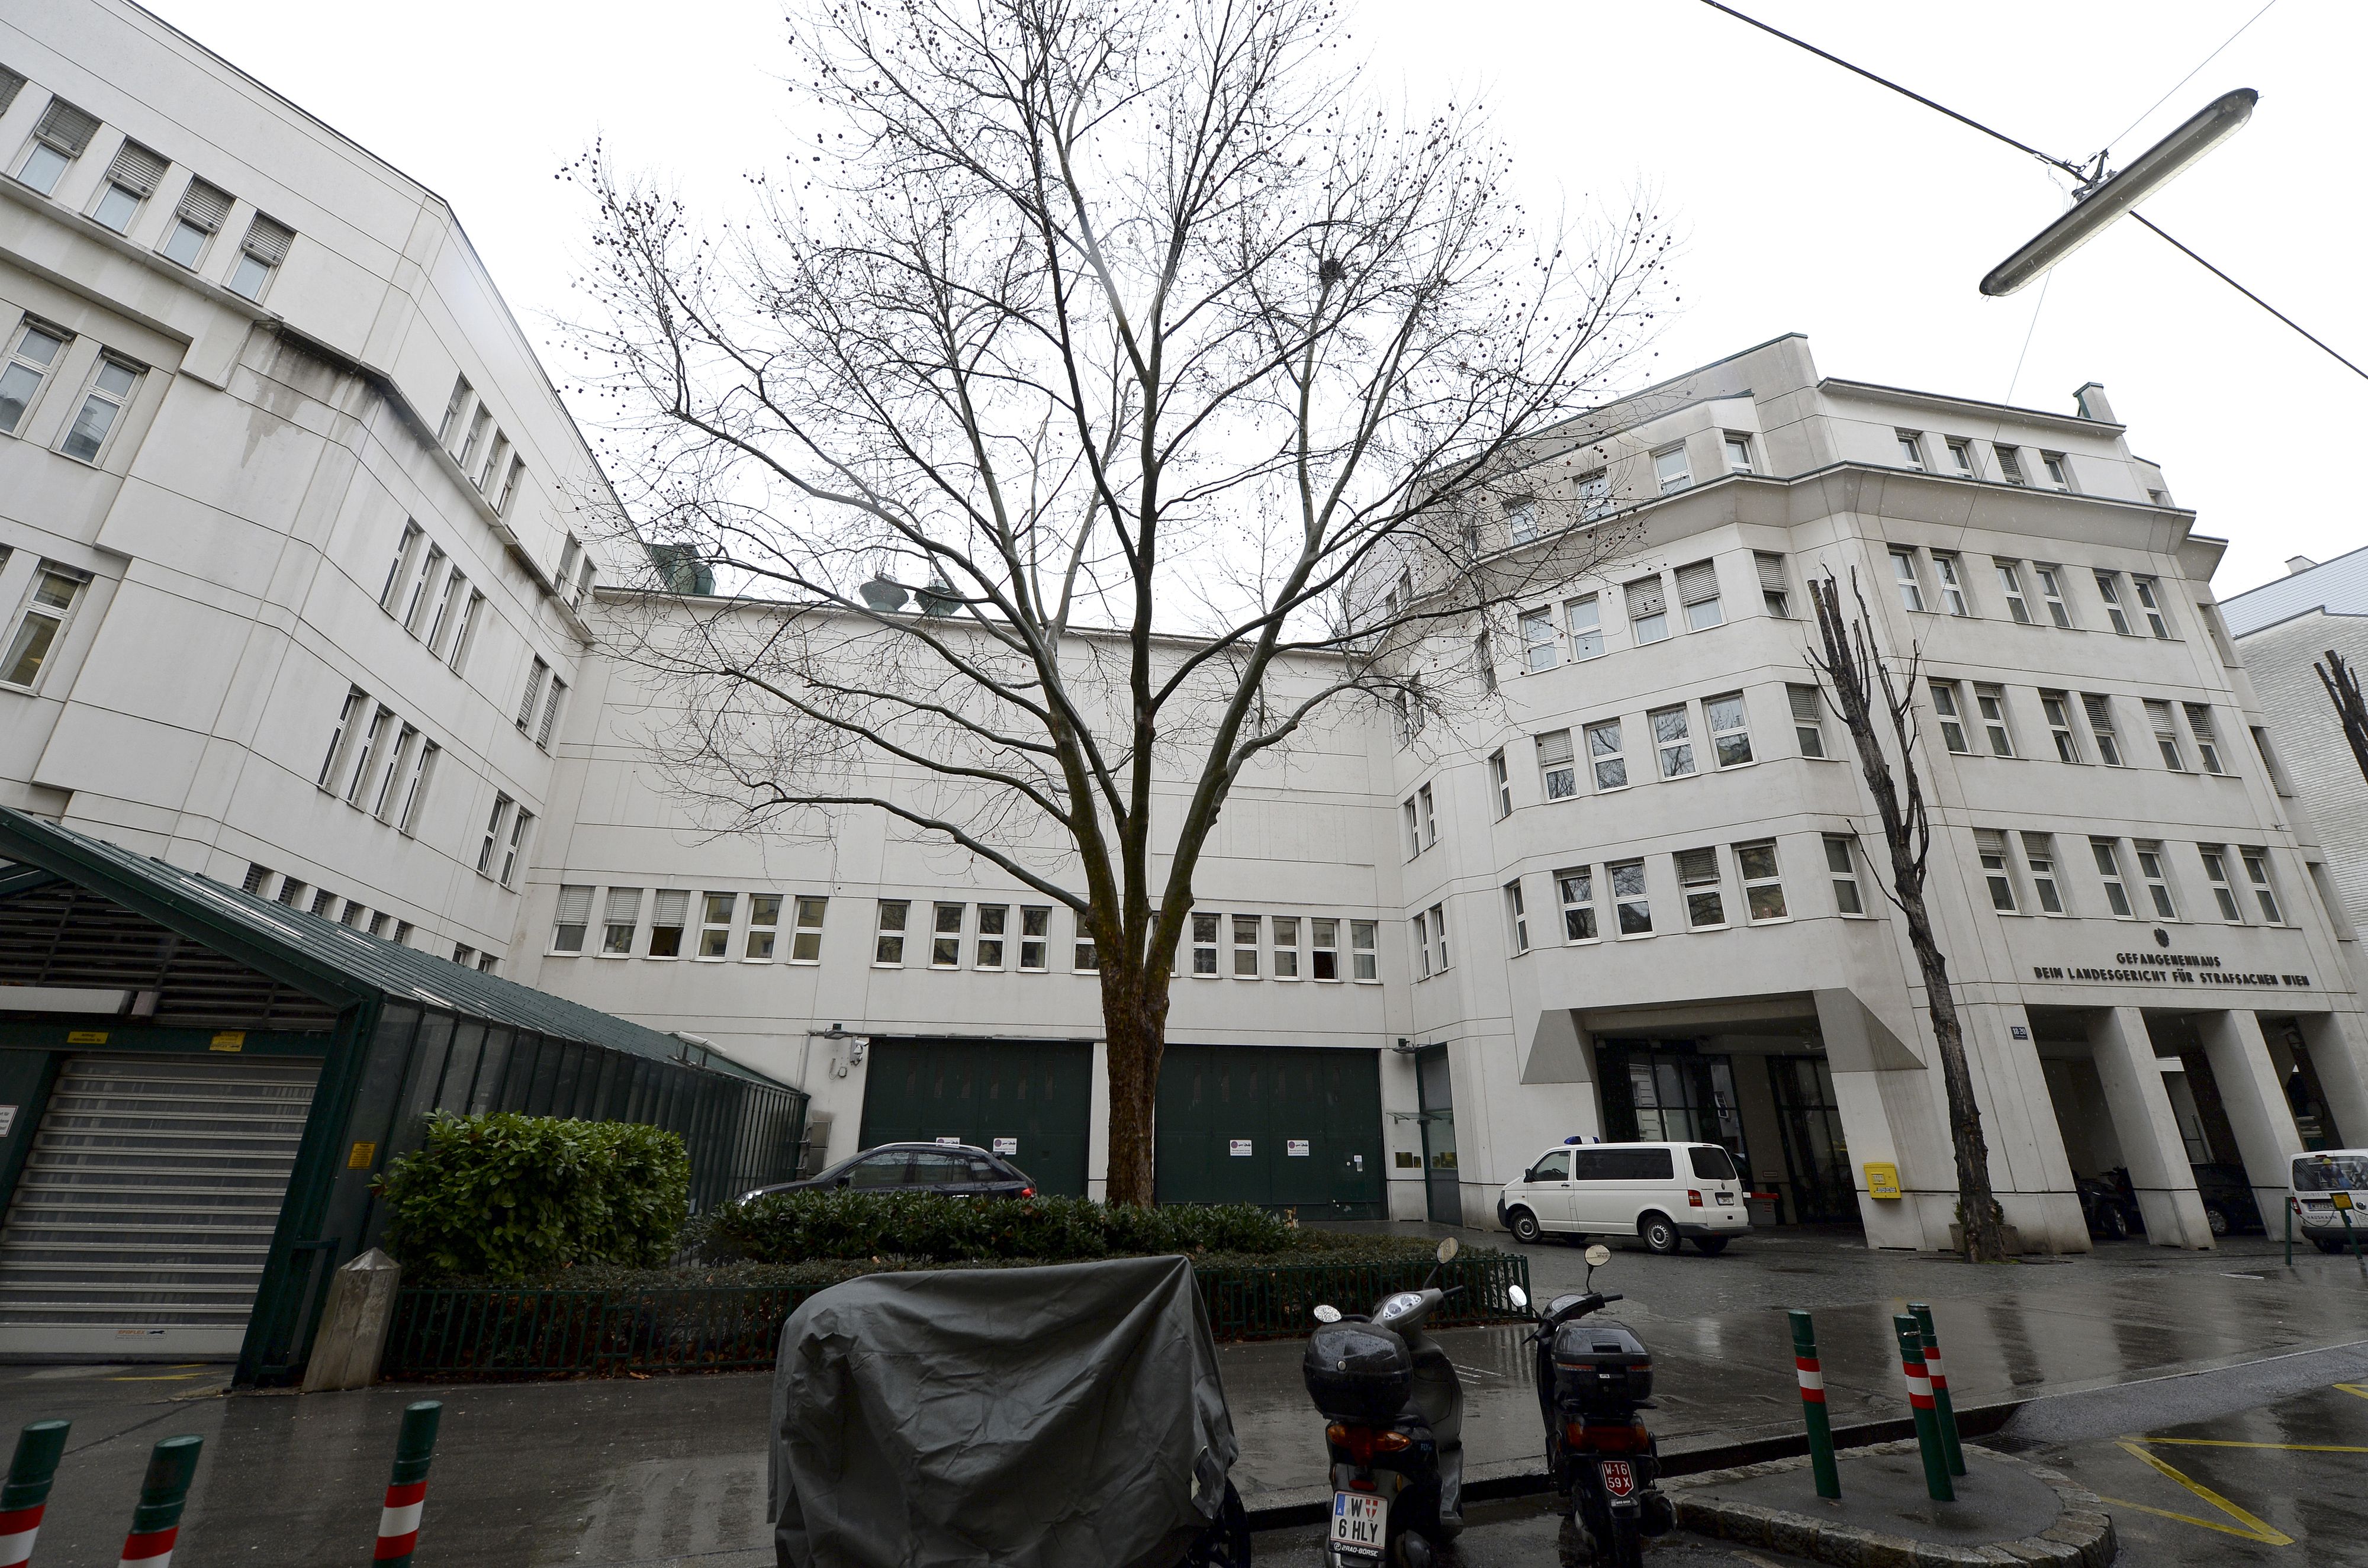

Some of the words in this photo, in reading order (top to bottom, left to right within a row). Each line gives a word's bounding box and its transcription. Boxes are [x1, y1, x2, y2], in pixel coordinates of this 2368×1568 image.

[2116, 952, 2221, 967] GEFANGENENHAUS
[2034, 967, 2064, 979] BEIM
[2067, 968, 2167, 981] LANDESGERICHT
[2172, 968, 2194, 983] FÜR
[2200, 972, 2279, 985] STRAFSACHEN
[2282, 974, 2311, 986] WIEN
[1607, 1477, 1621, 1488] 59
[1623, 1477, 1630, 1487] X
[1351, 1498, 1363, 1517] W
[1339, 1518, 1347, 1538] 6
[1352, 1520, 1378, 1543] HLY
[1341, 1545, 1379, 1557] 2RAD-BÖRSE
